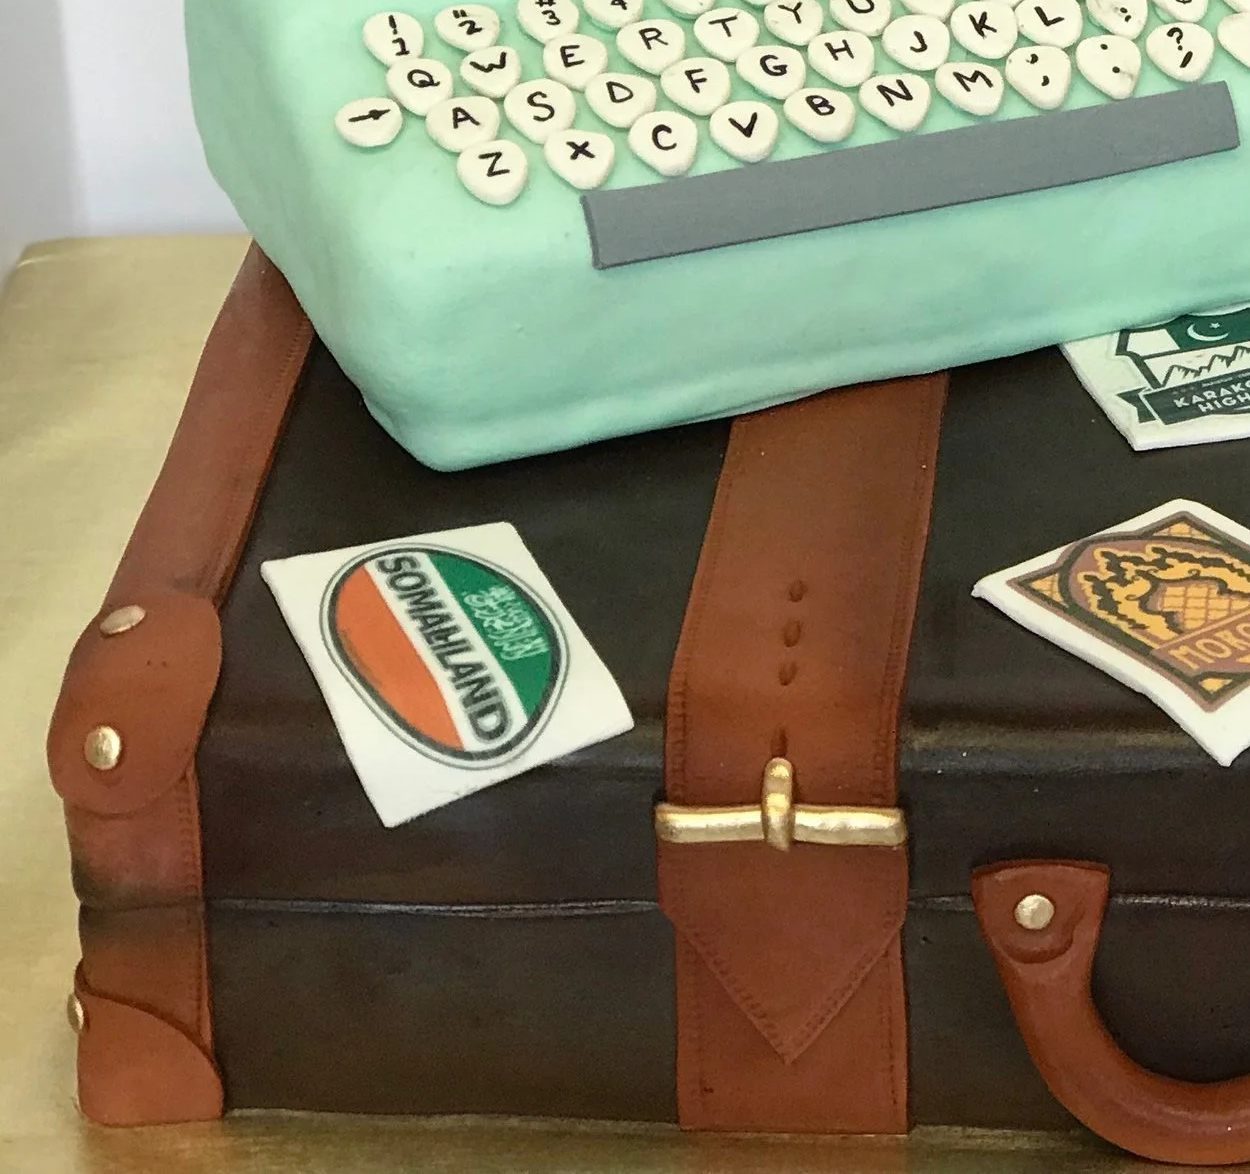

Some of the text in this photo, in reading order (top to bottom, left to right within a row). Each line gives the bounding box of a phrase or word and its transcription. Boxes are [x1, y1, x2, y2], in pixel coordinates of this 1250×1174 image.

[406, 68, 440, 89] Q
[470, 51, 507, 74] W
[560, 44, 585, 68] E
[639, 27, 669, 51] R
[708, 15, 738, 38] T
[778, 1, 802, 24] Y
[453, 106, 481, 129] A
[526, 91, 555, 122] S
[605, 81, 634, 104] D
[685, 68, 708, 94] F
[759, 54, 788, 77] G
[825, 39, 855, 61] H
[909, 30, 928, 53] J
[968, 11, 998, 39] K
[1034, 6, 1065, 27] L
[459, 20, 482, 36] 2
[542, 9, 560, 26] 3
[479, 152, 510, 178] Z
[566, 141, 596, 161] X
[651, 125, 677, 151] C
[728, 112, 758, 139] V
[806, 94, 836, 116] B
[876, 79, 914, 107] N
[953, 69, 994, 93] M
[377, 555, 513, 743] SOMALILAND
